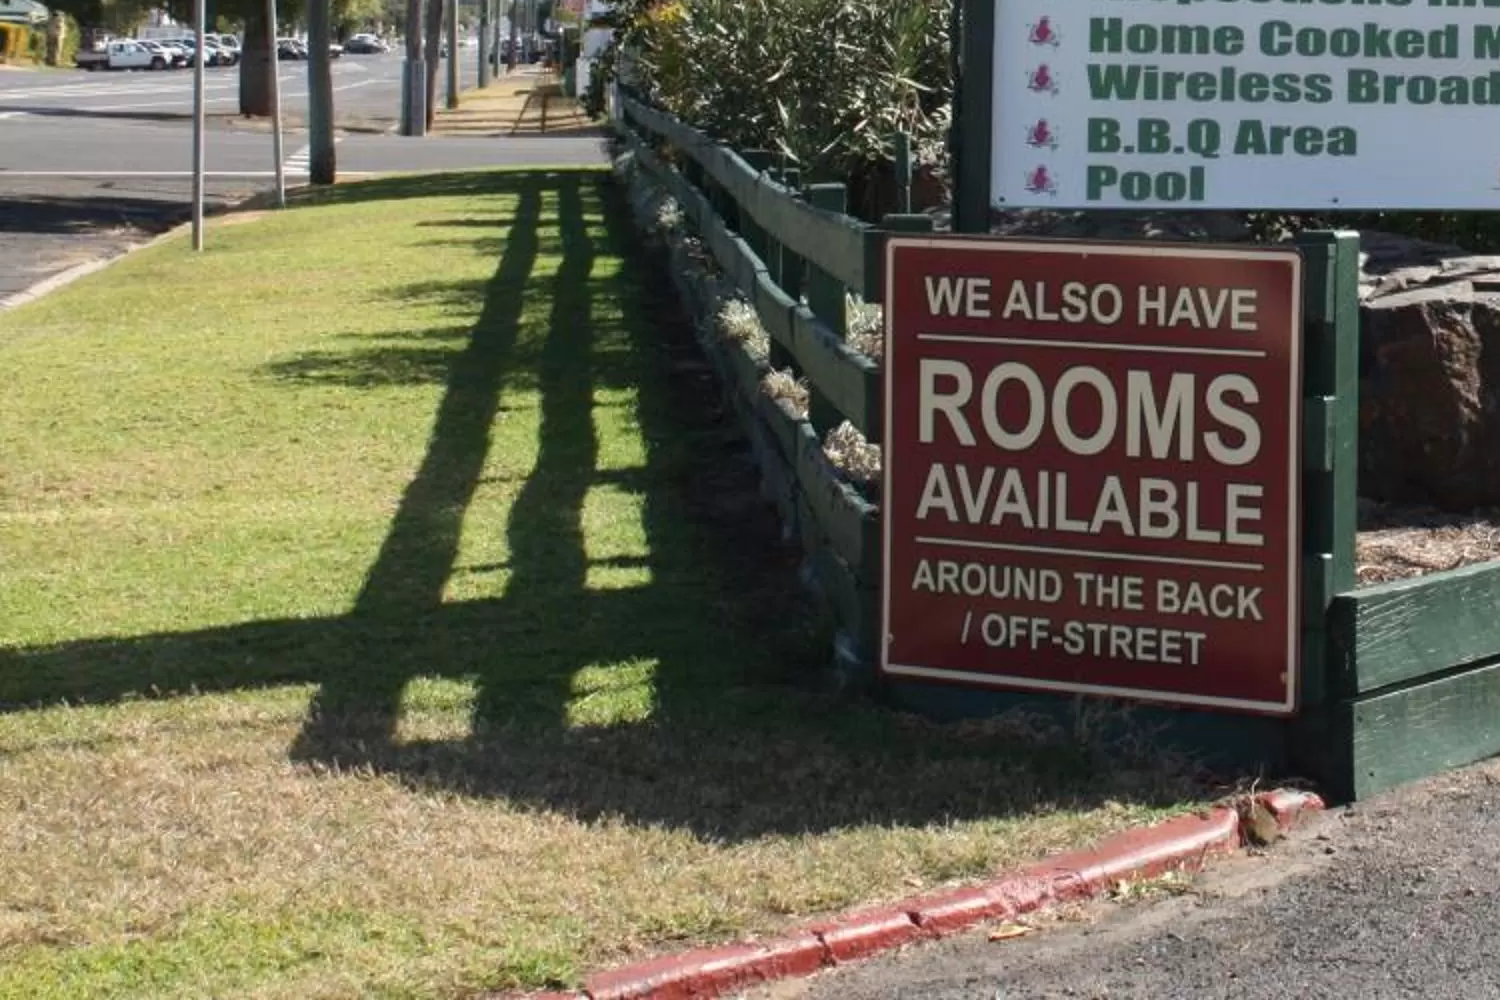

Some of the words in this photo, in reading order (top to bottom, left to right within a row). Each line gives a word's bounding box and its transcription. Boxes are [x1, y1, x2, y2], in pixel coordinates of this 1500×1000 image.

[1089, 17, 1244, 56] Home
[1259, 20, 1458, 59] Cooked
[1087, 64, 1332, 104] Wireless
[1087, 118, 1220, 159] B.B.Q
[1234, 120, 1358, 157] Area
[1086, 165, 1205, 201] Pool
[925, 276, 991, 318] WE
[1003, 281, 1122, 325] ALSO
[1138, 286, 1258, 331] HAVE
[919, 358, 1262, 466] ROOMS
[916, 463, 1264, 546] AVAILABLE
[912, 559, 1062, 602] AROUND
[1074, 571, 1144, 610] THE
[1157, 579, 1263, 621] BACK
[982, 614, 1207, 666] OFF-STREET
